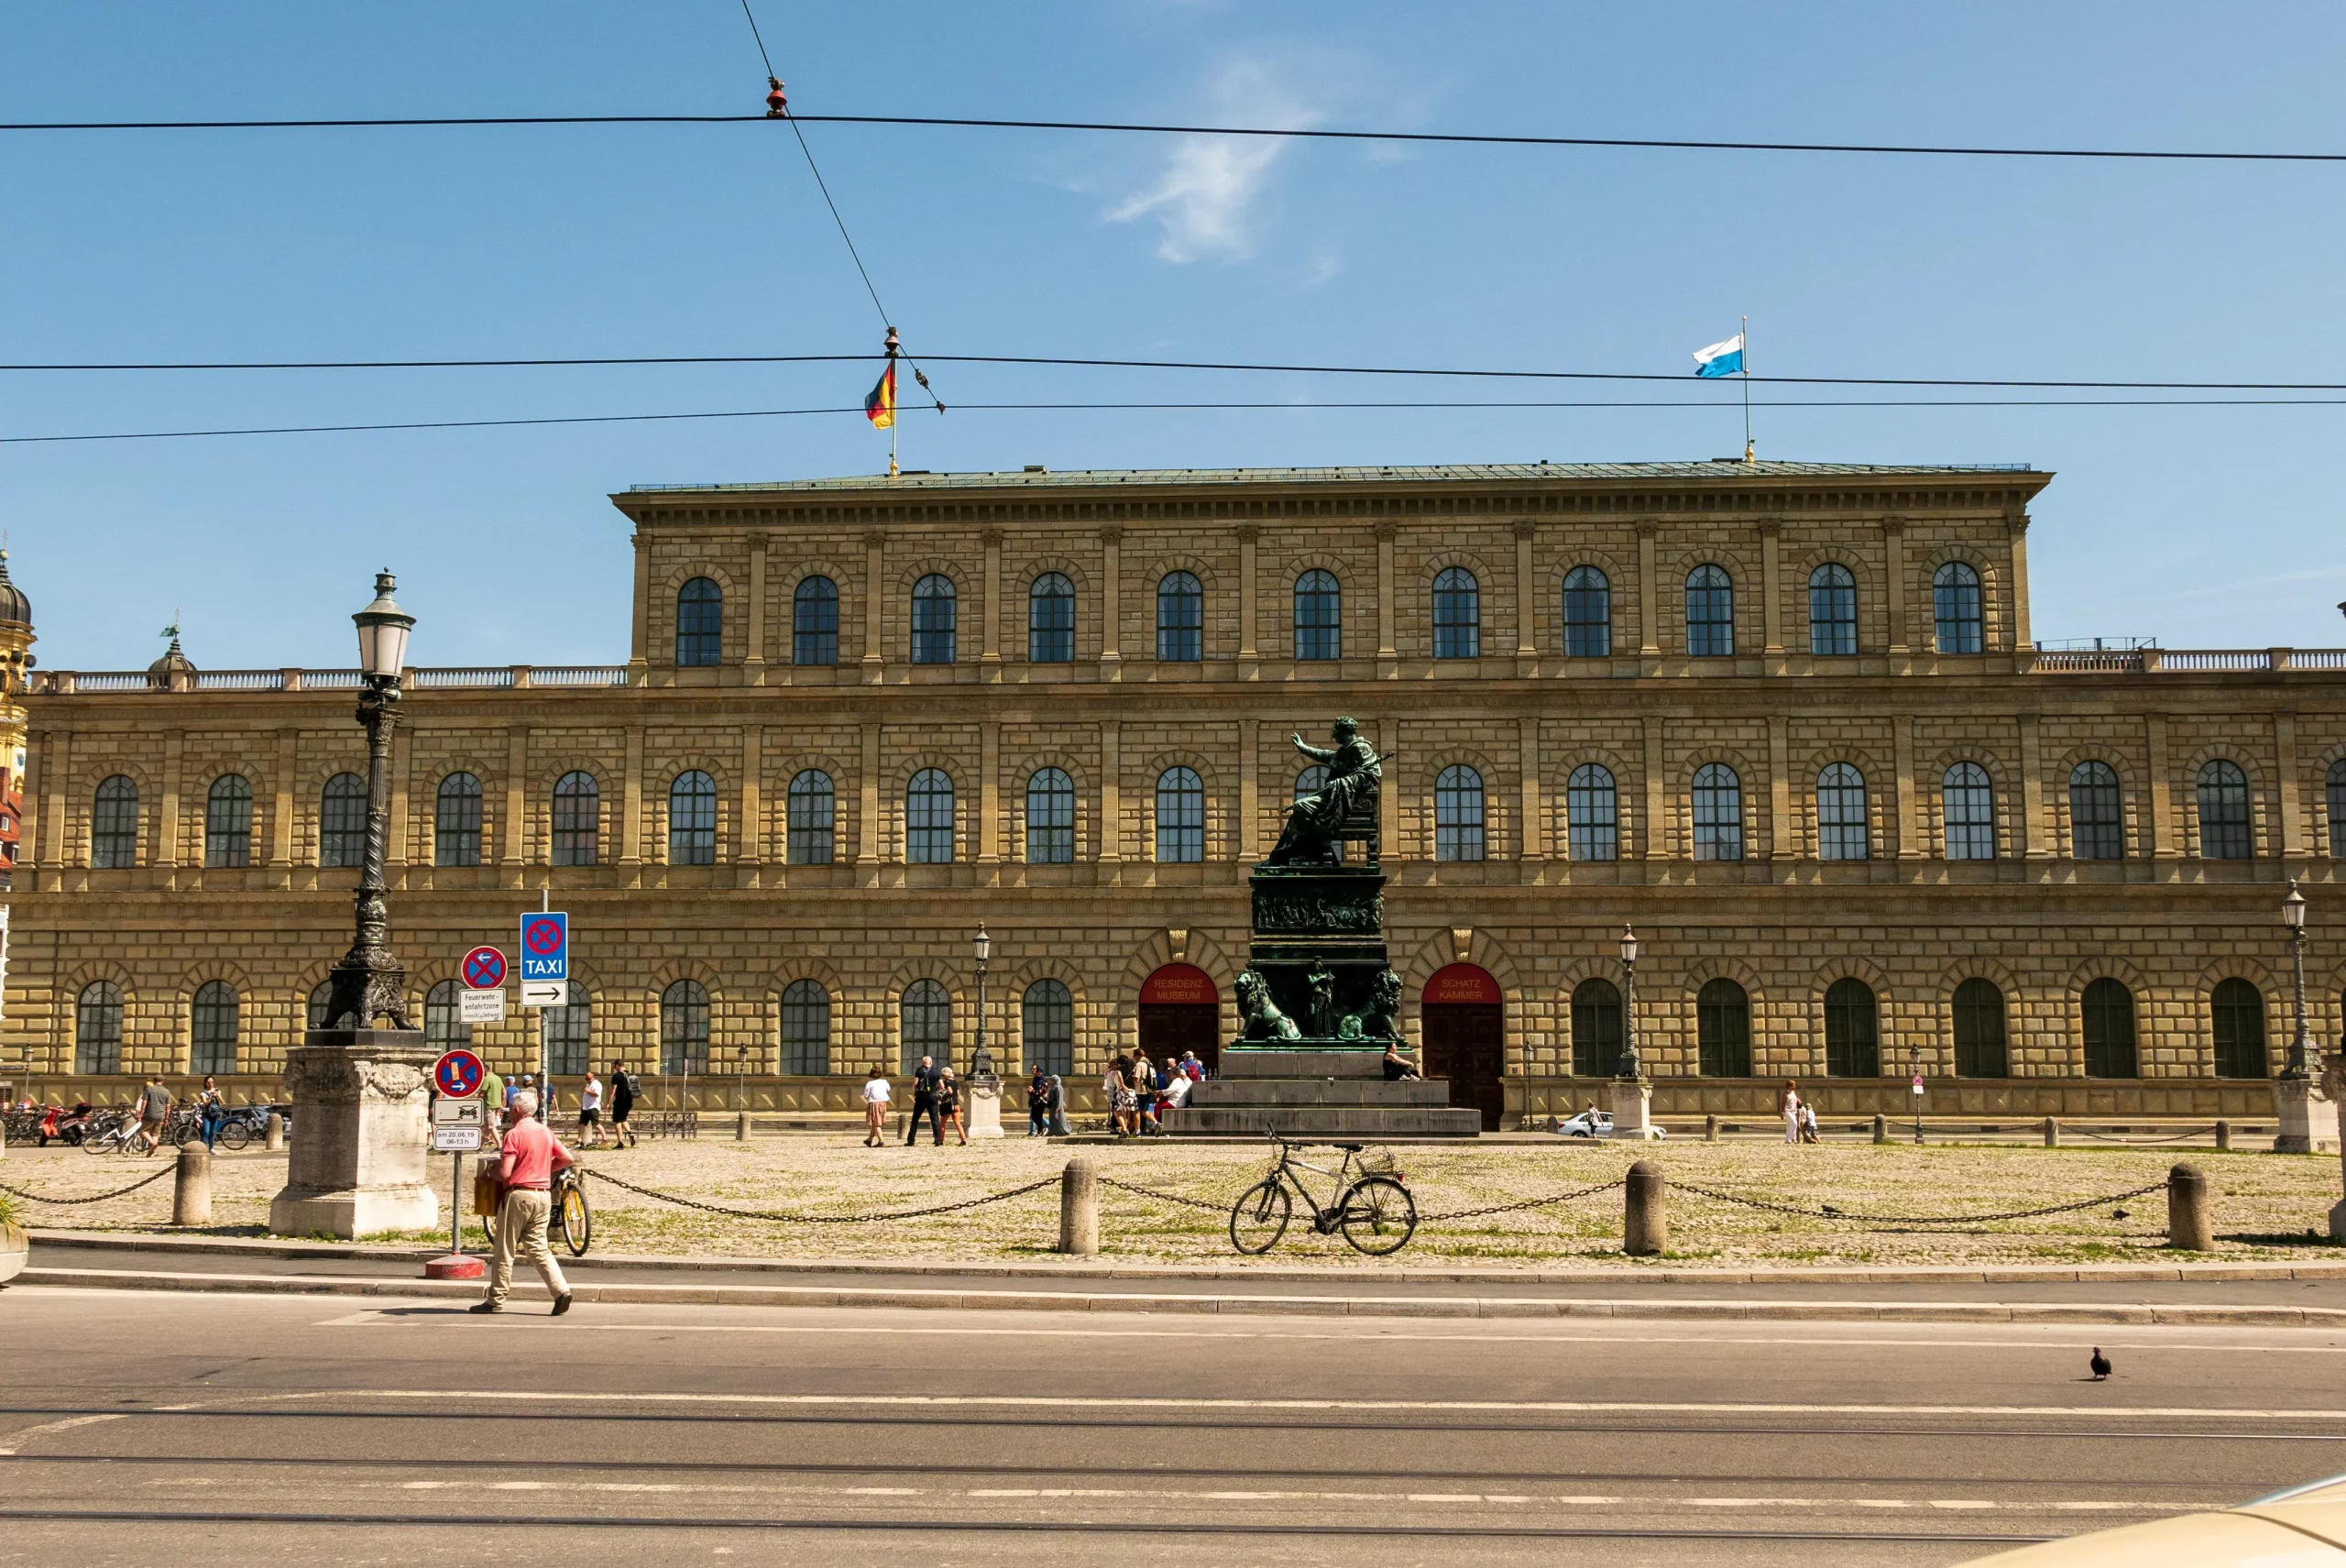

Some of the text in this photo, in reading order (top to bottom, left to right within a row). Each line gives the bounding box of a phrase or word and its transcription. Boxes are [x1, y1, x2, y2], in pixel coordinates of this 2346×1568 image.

[525, 959, 563, 974] TAXI
[1154, 979, 1203, 988] RESIDENZ
[1442, 979, 1481, 988] SCHATZ
[1157, 991, 1200, 1000] MUSEUM
[1439, 991, 1483, 1000] KAMMER
